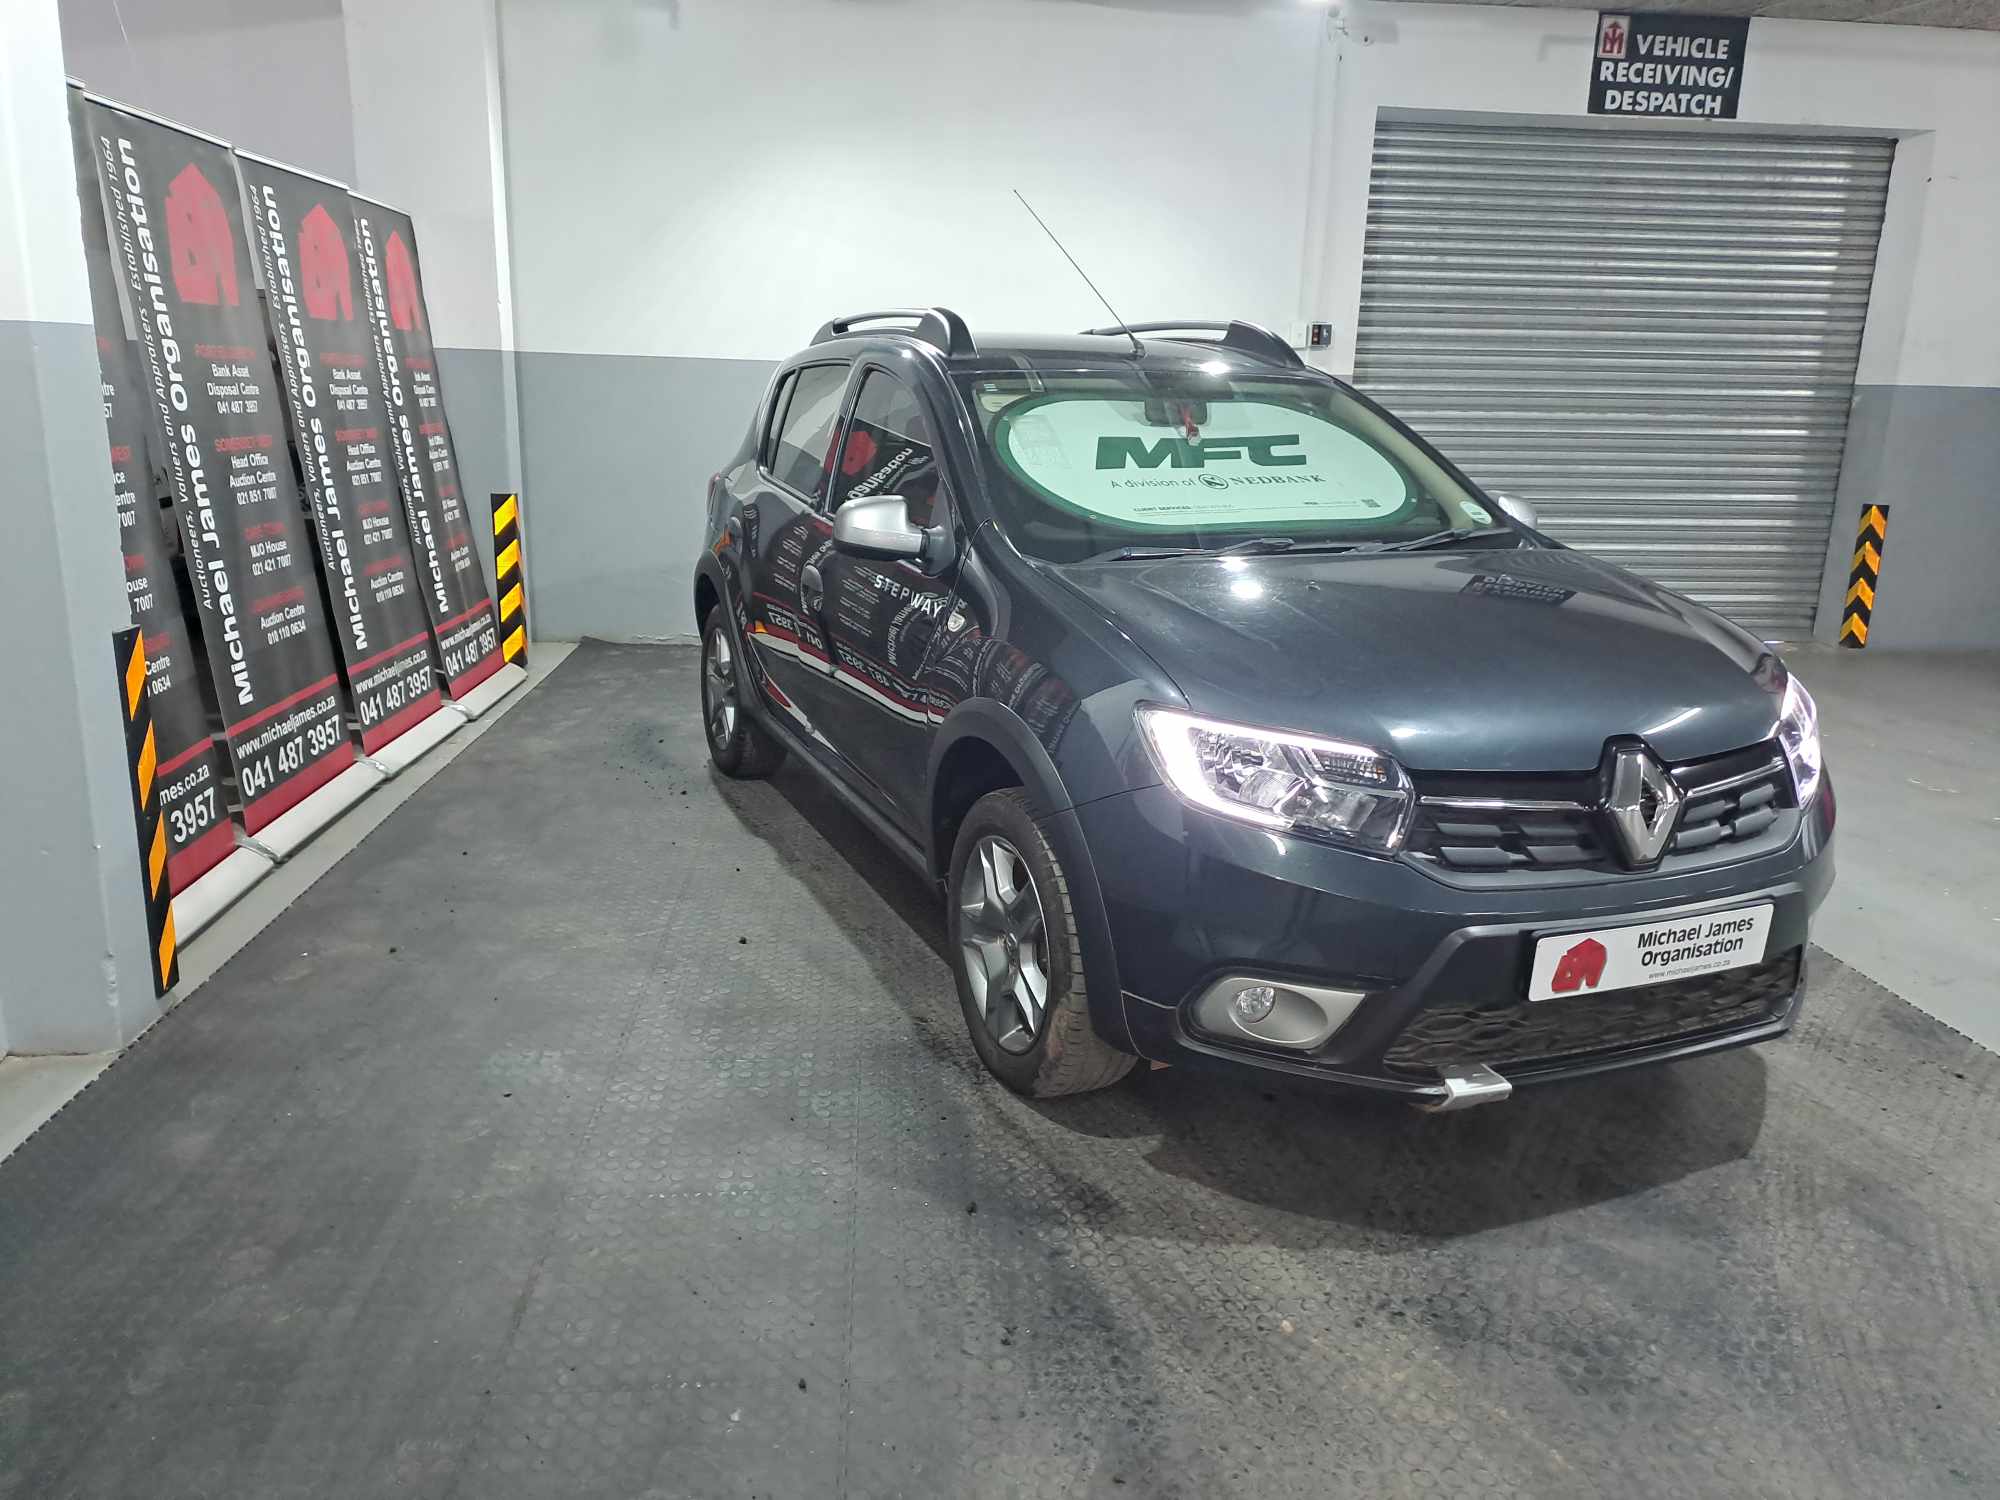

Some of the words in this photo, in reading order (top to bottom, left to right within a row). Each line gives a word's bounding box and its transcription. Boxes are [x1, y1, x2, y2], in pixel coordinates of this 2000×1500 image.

[1600, 61, 1735, 88] RECEIVING/
[1636, 34, 1730, 60] VEHICLE
[1604, 90, 1722, 115] DESPATCH
[100, 135, 118, 182] 1964
[110, 186, 142, 290] Established
[118, 138, 188, 411] Organisation
[263, 185, 316, 407] Organisation
[360, 218, 403, 407] Organisation
[140, 311, 167, 399] Appraisers
[157, 403, 174, 436] and
[293, 400, 305, 428] and
[169, 440, 188, 503] Valuers
[310, 418, 341, 521] James
[399, 414, 425, 502] James
[1096, 434, 1307, 470] MFC
[1111, 479, 1121, 488] A
[1124, 478, 1178, 488] division
[1181, 478, 1196, 487] of
[1227, 473, 1326, 486] NEDBANK
[181, 424, 220, 548] James
[126, 577, 148, 593] ouse
[185, 510, 213, 609] Auctioneers,
[417, 510, 449, 613] Michael
[332, 529, 368, 650] Michael
[874, 575, 943, 618] STEPWAY
[208, 559, 254, 705] Michael
[445, 649, 464, 677] 041
[465, 639, 479, 665] 487
[479, 627, 497, 655] 3957
[145, 655, 171, 676] Centre
[360, 692, 384, 725] 041
[386, 681, 406, 710] 487
[407, 665, 432, 698] 3957
[236, 694, 336, 760] www.michaeljames.co.za
[242, 756, 272, 797] 041
[278, 735, 303, 776] 487
[307, 714, 341, 756] 3957
[160, 763, 210, 806] mes.co.za
[170, 787, 216, 843] 3957
[1637, 924, 1702, 949] Michael
[1705, 916, 1754, 938] James
[1641, 936, 1743, 967] Organisation
